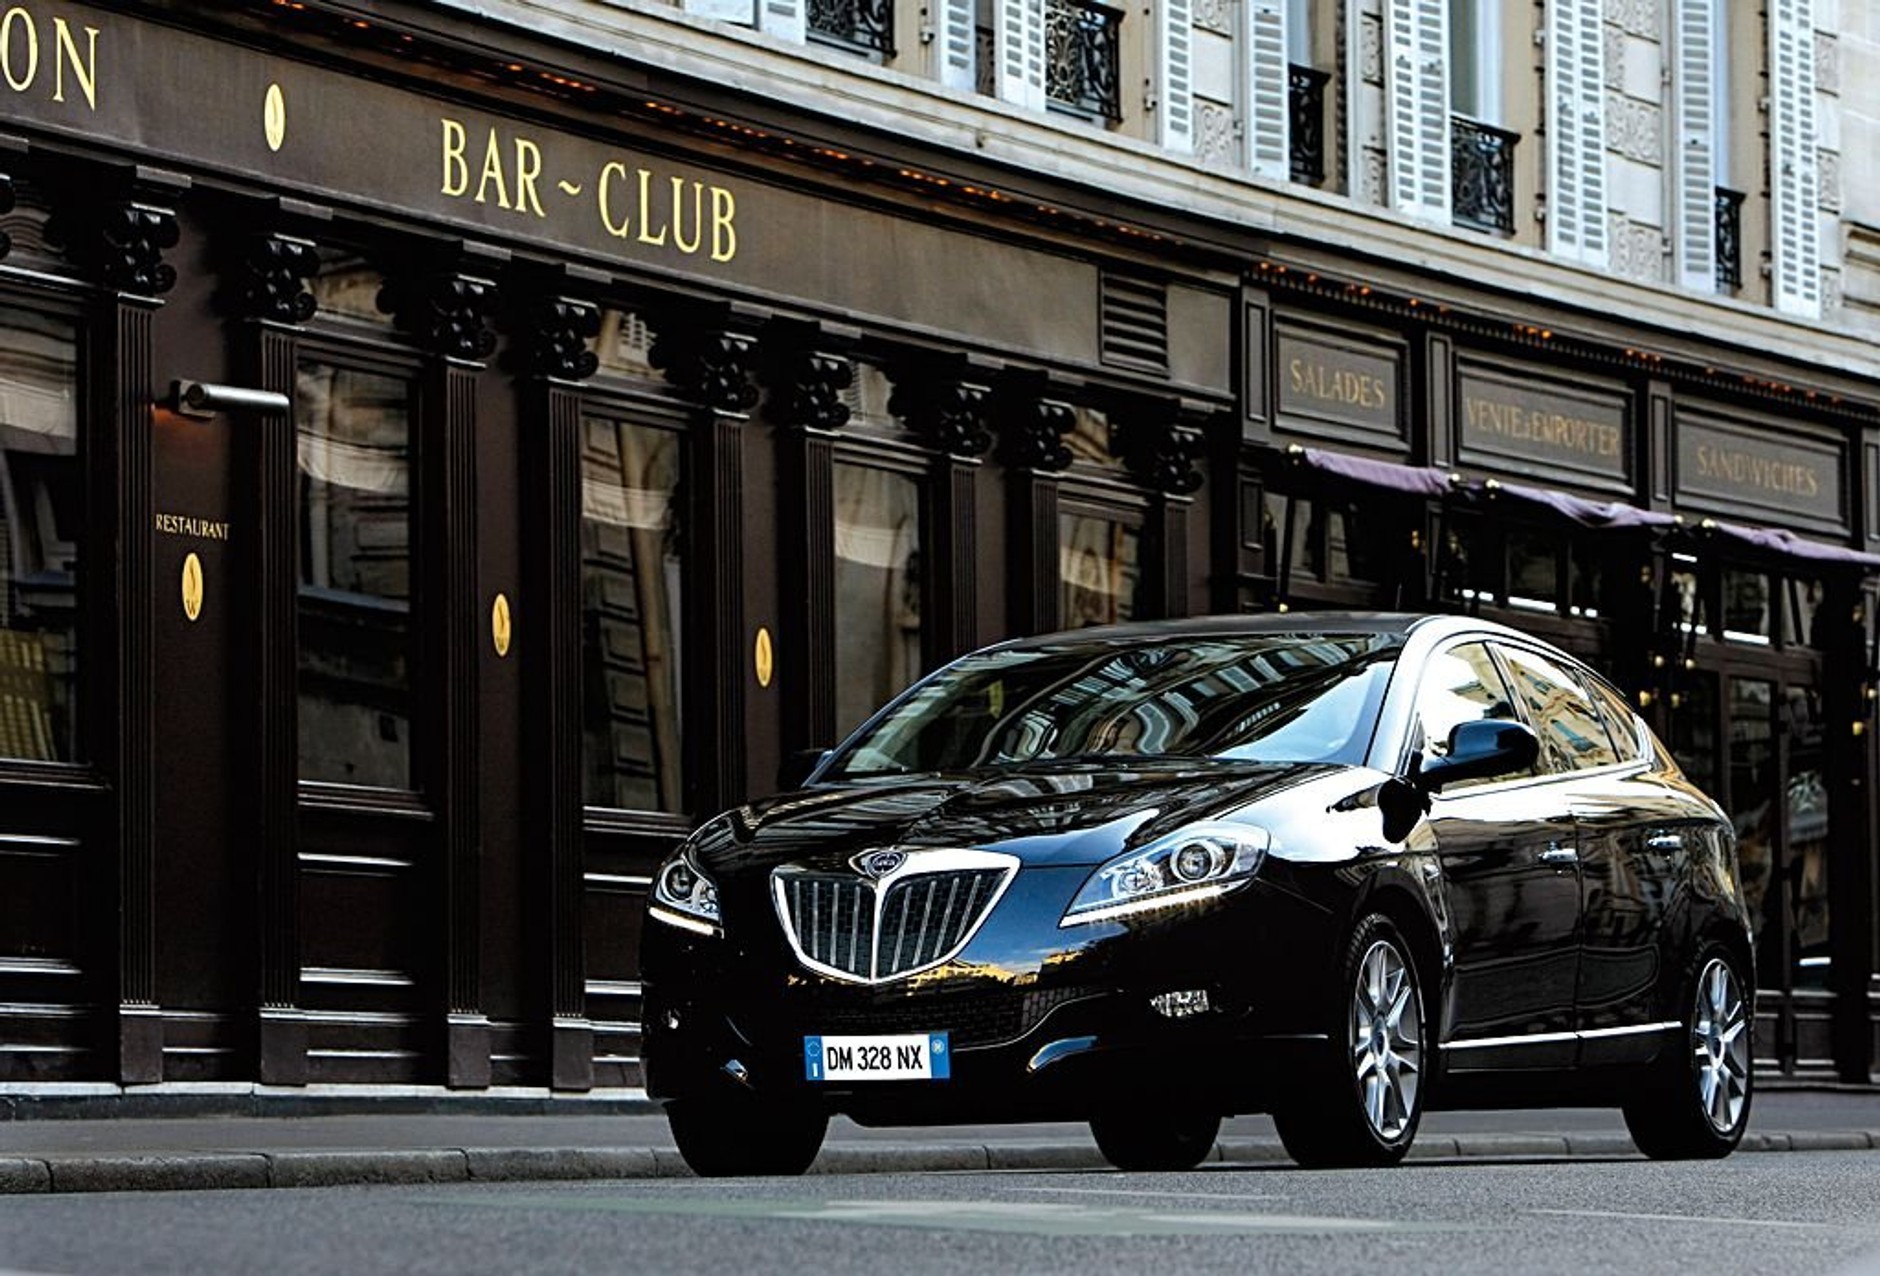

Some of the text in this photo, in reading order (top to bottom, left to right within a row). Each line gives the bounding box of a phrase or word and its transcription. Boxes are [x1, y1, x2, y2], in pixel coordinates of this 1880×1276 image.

[441, 118, 545, 217] BAR
[598, 161, 737, 262] CLUB
[1290, 359, 1385, 409] SALADES
[1467, 397, 1523, 439] VENTE
[1531, 411, 1620, 456] EMPORTER
[1697, 445, 1818, 497] SANDWICHES
[155, 514, 229, 541] RESTAURANT
[827, 1044, 923, 1071] DM 328 NX
